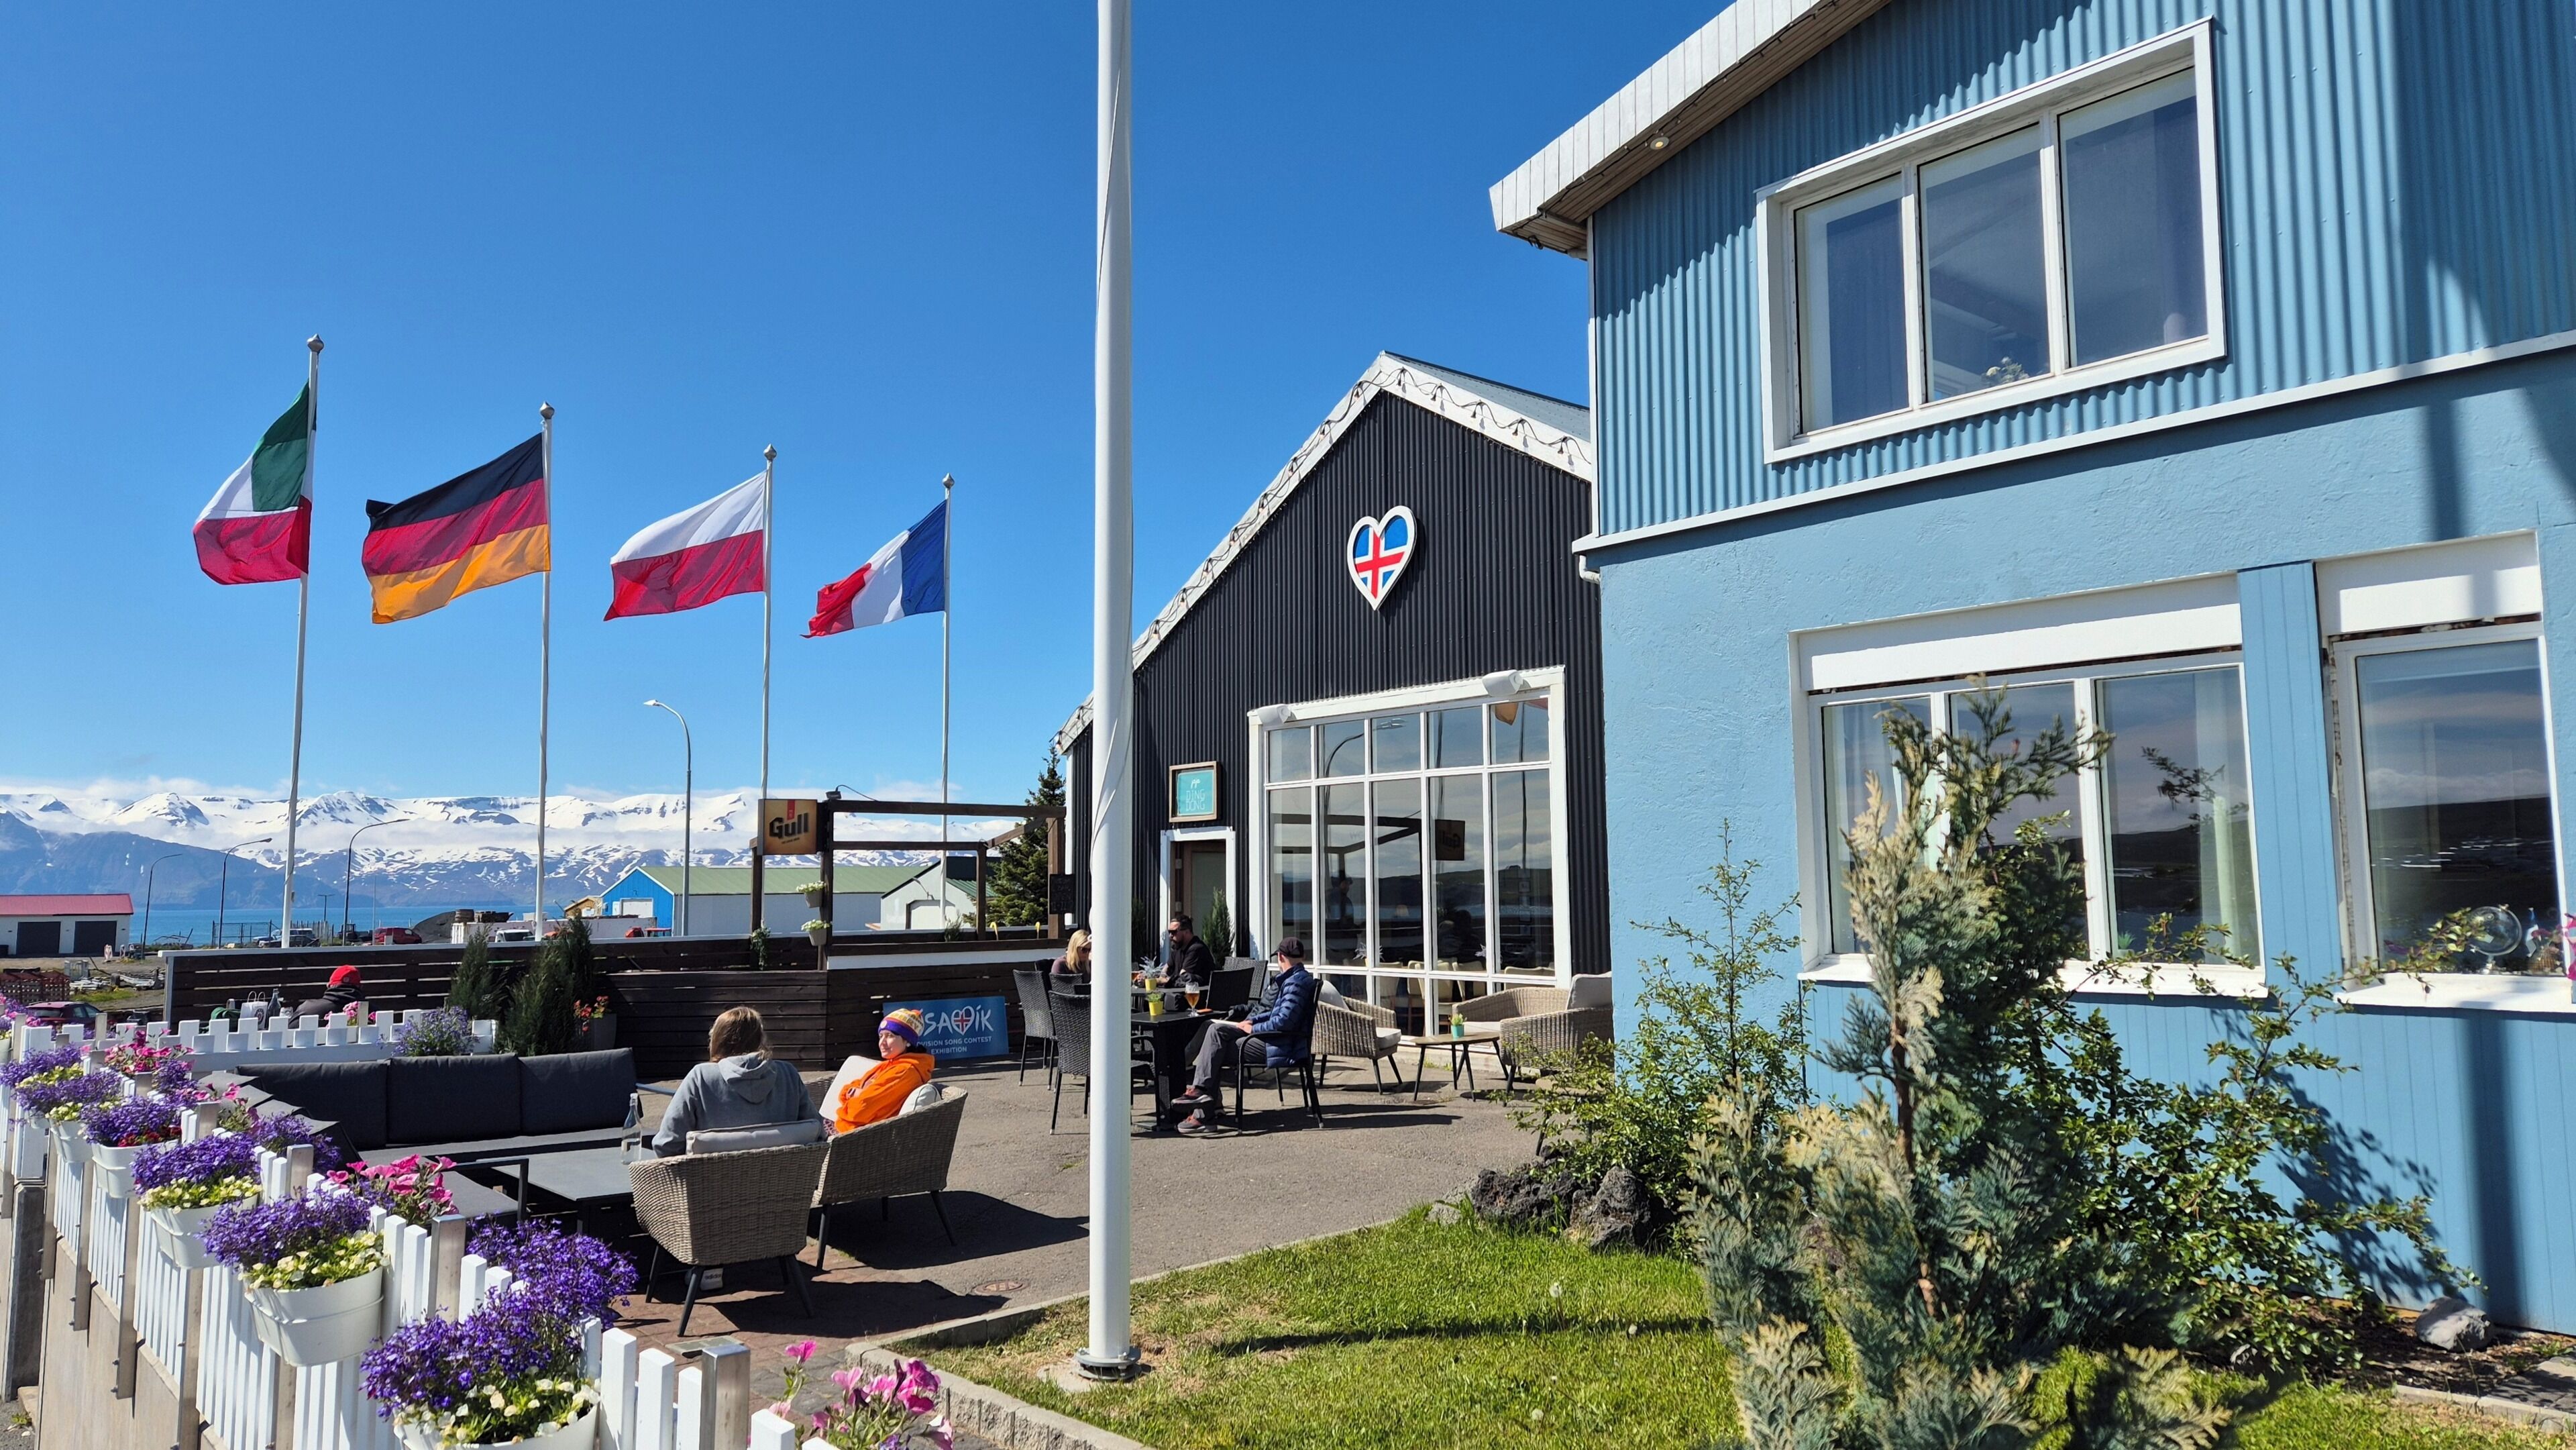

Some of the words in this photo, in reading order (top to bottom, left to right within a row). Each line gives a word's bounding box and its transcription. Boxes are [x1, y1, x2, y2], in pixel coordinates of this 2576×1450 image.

[1186, 789, 1205, 800] DING
[1186, 799, 1205, 811] DONG
[769, 813, 808, 839] Gull
[964, 1036, 992, 1044] CONTEST
[930, 1046, 967, 1055] EXHIBITION
